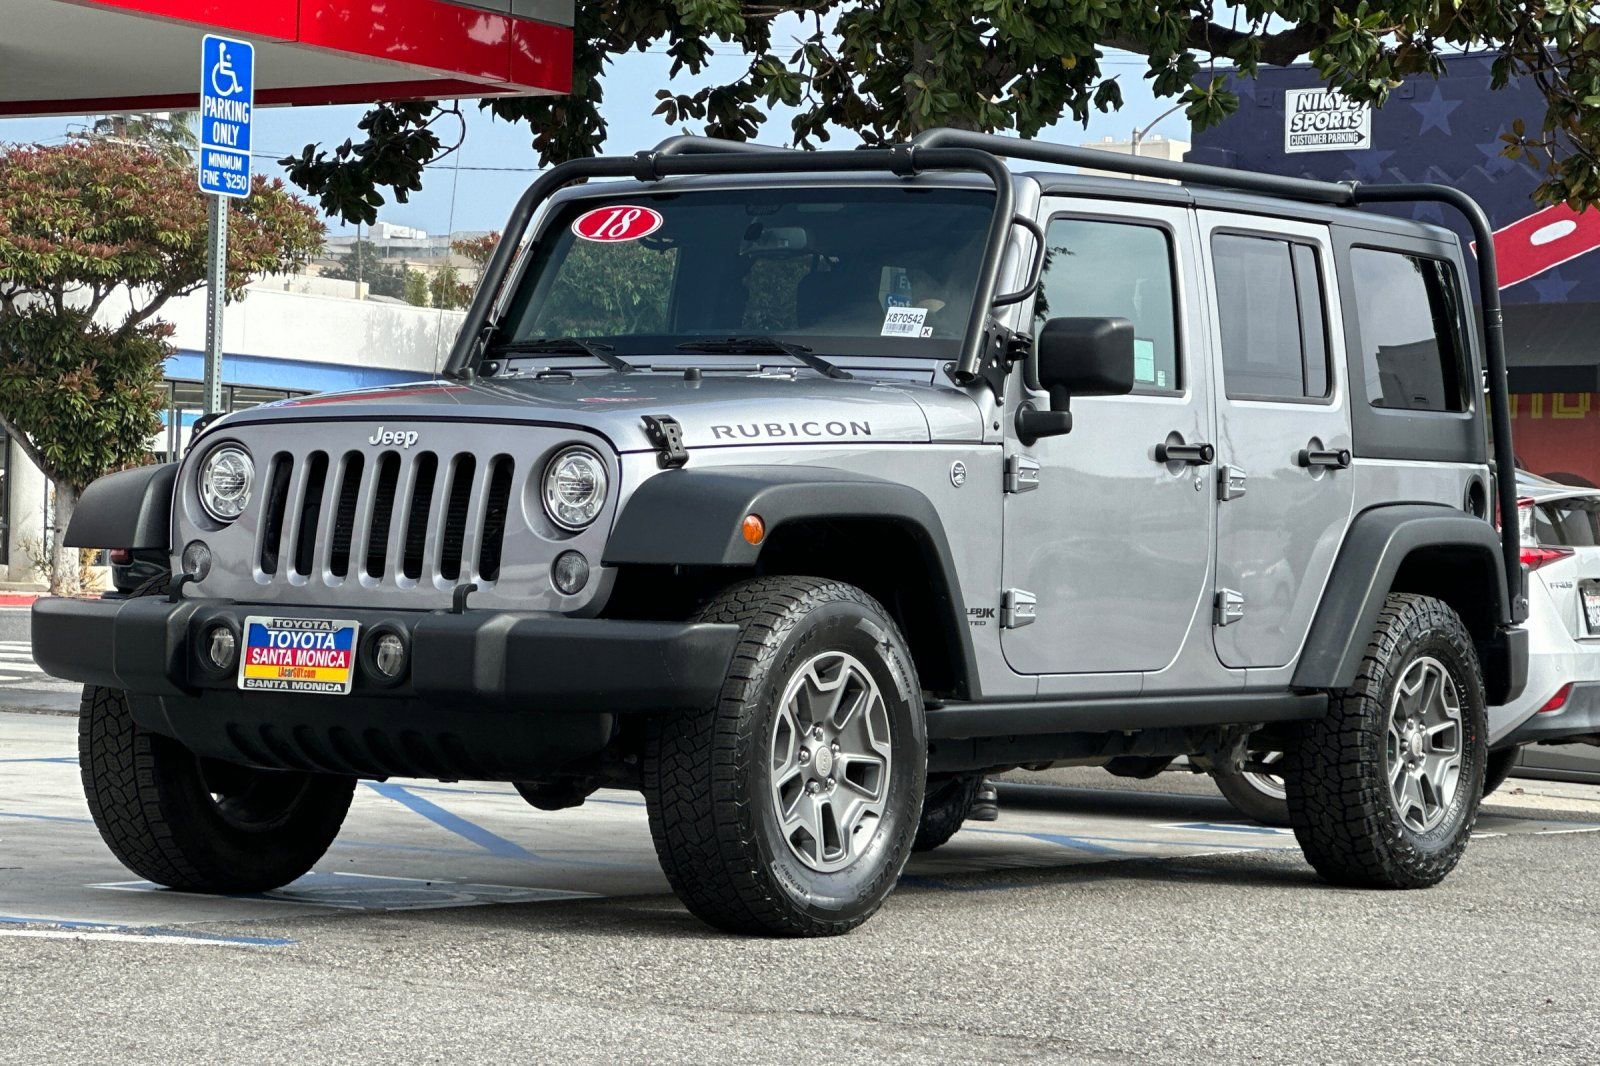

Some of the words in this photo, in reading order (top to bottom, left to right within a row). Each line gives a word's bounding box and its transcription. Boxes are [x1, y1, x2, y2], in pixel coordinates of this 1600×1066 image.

[204, 95, 249, 124] PARKING
[1290, 110, 1363, 132] SPORTS
[213, 121, 239, 146] ONLY
[1291, 134, 1327, 146] CUSTOMER
[1328, 131, 1359, 144] PARKING
[208, 151, 242, 171] MINIMUM
[202, 169, 220, 186] FINE
[225, 172, 247, 190] $250
[588, 208, 641, 237] 18
[887, 313, 923, 324] X870542
[368, 426, 418, 449] Jeep
[710, 421, 872, 439] RUBICON
[274, 620, 331, 630] TOYOTA
[267, 630, 336, 650] TOYOTA
[252, 648, 293, 665] SANTA
[295, 650, 346, 667] MONICA
[246, 679, 289, 689] SANTA
[291, 682, 342, 692] MONICA
